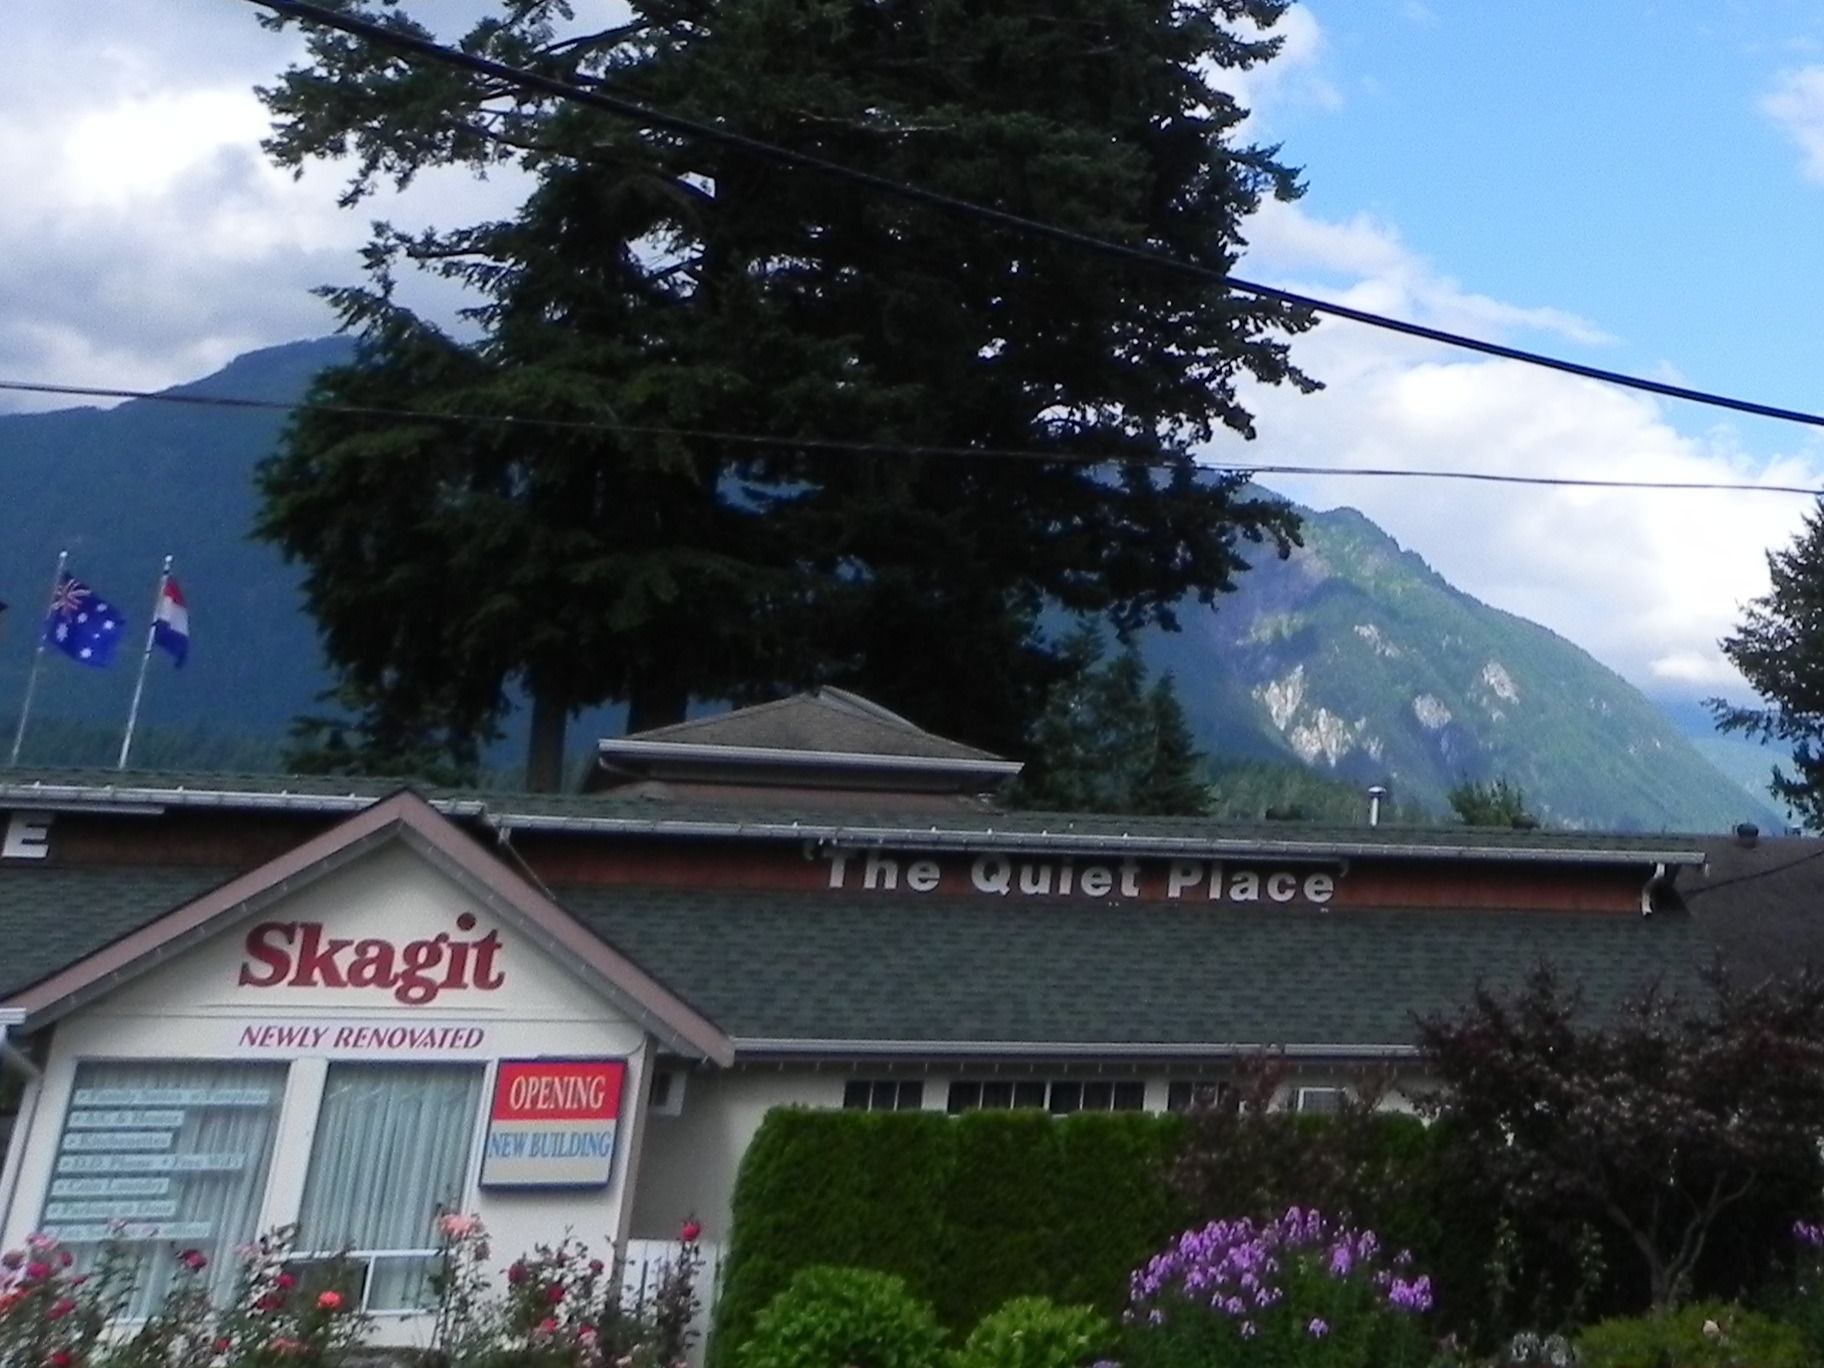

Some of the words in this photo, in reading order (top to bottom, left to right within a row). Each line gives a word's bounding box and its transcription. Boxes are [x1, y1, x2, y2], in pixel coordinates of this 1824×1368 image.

[971, 852, 1142, 898] Quiet
[1167, 856, 1335, 904] Place
[237, 911, 506, 1006] Skagit
[238, 1025, 329, 1048] NEWLY
[333, 1027, 485, 1050] RENOVATED
[509, 1075, 606, 1111] OPENING
[487, 1132, 529, 1158] NEW
[528, 1132, 612, 1159] BUILDING
